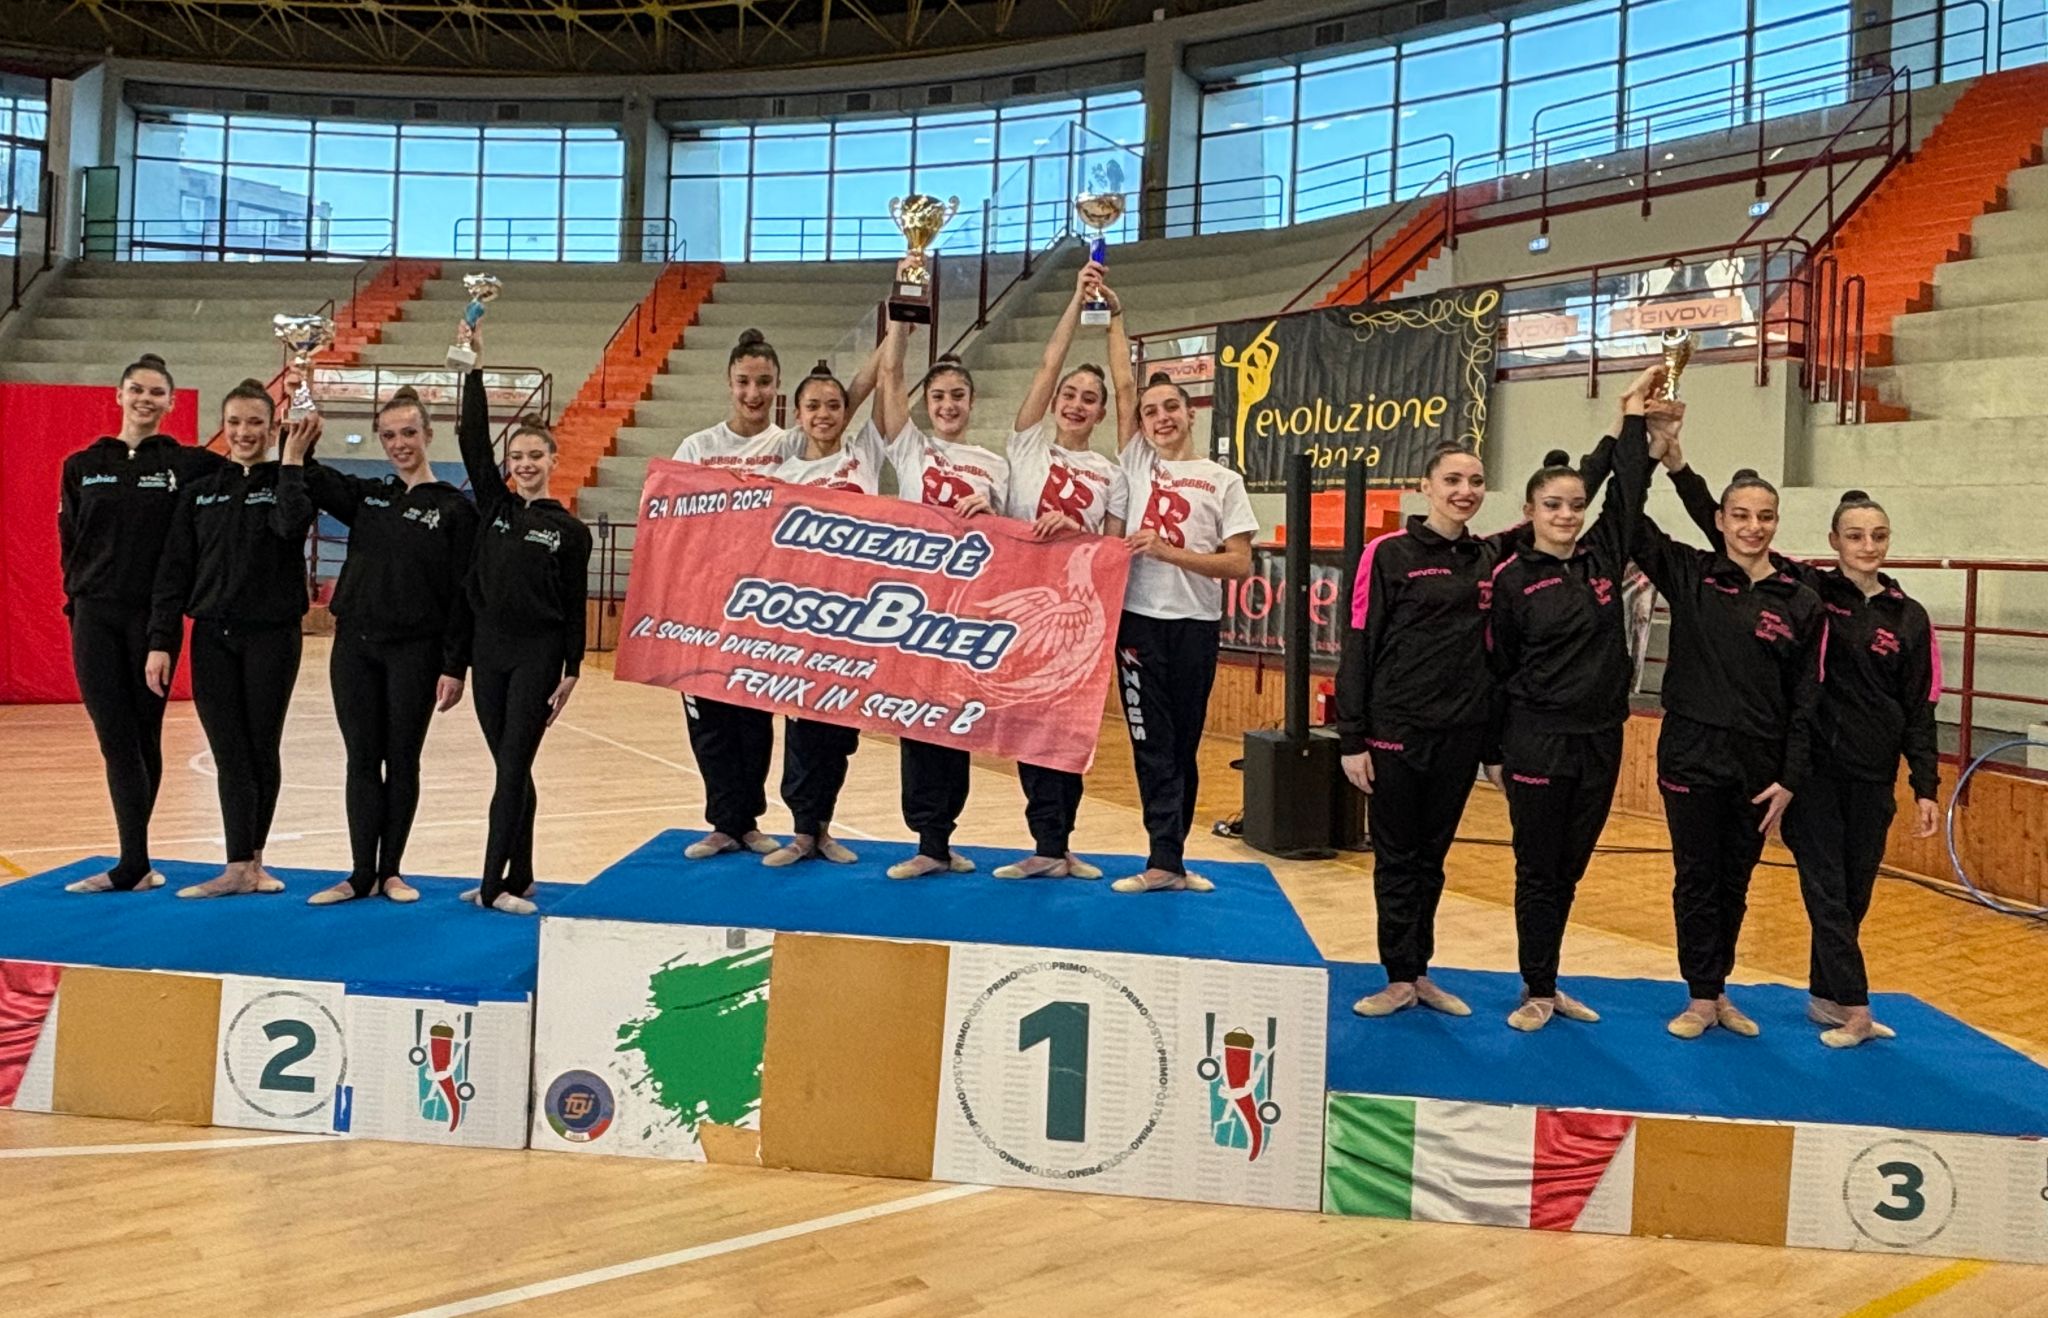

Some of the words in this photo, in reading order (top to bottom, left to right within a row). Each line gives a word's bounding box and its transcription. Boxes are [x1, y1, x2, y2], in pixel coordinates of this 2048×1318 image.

[1641, 303, 1729, 325] GIVOVA
[1256, 394, 1448, 437] evoluzione
[649, 499, 669, 519] 24
[673, 493, 727, 517] MARZO
[732, 489, 773, 511] 2024
[779, 512, 950, 568] INSIEME
[952, 538, 985, 574] È
[631, 616, 651, 638] IL
[655, 621, 722, 649] SOGNO
[721, 634, 805, 667] DIVENTA
[805, 655, 878, 682] REALTÀ
[726, 668, 818, 708] FENIX
[814, 685, 859, 713] IN
[860, 693, 950, 728] SERIE
[949, 701, 986, 735] B
[1121, 666, 1147, 741] Zeus
[258, 1019, 317, 1094] 2
[1018, 1000, 1090, 1143] 1
[1873, 1160, 1925, 1222] 3
